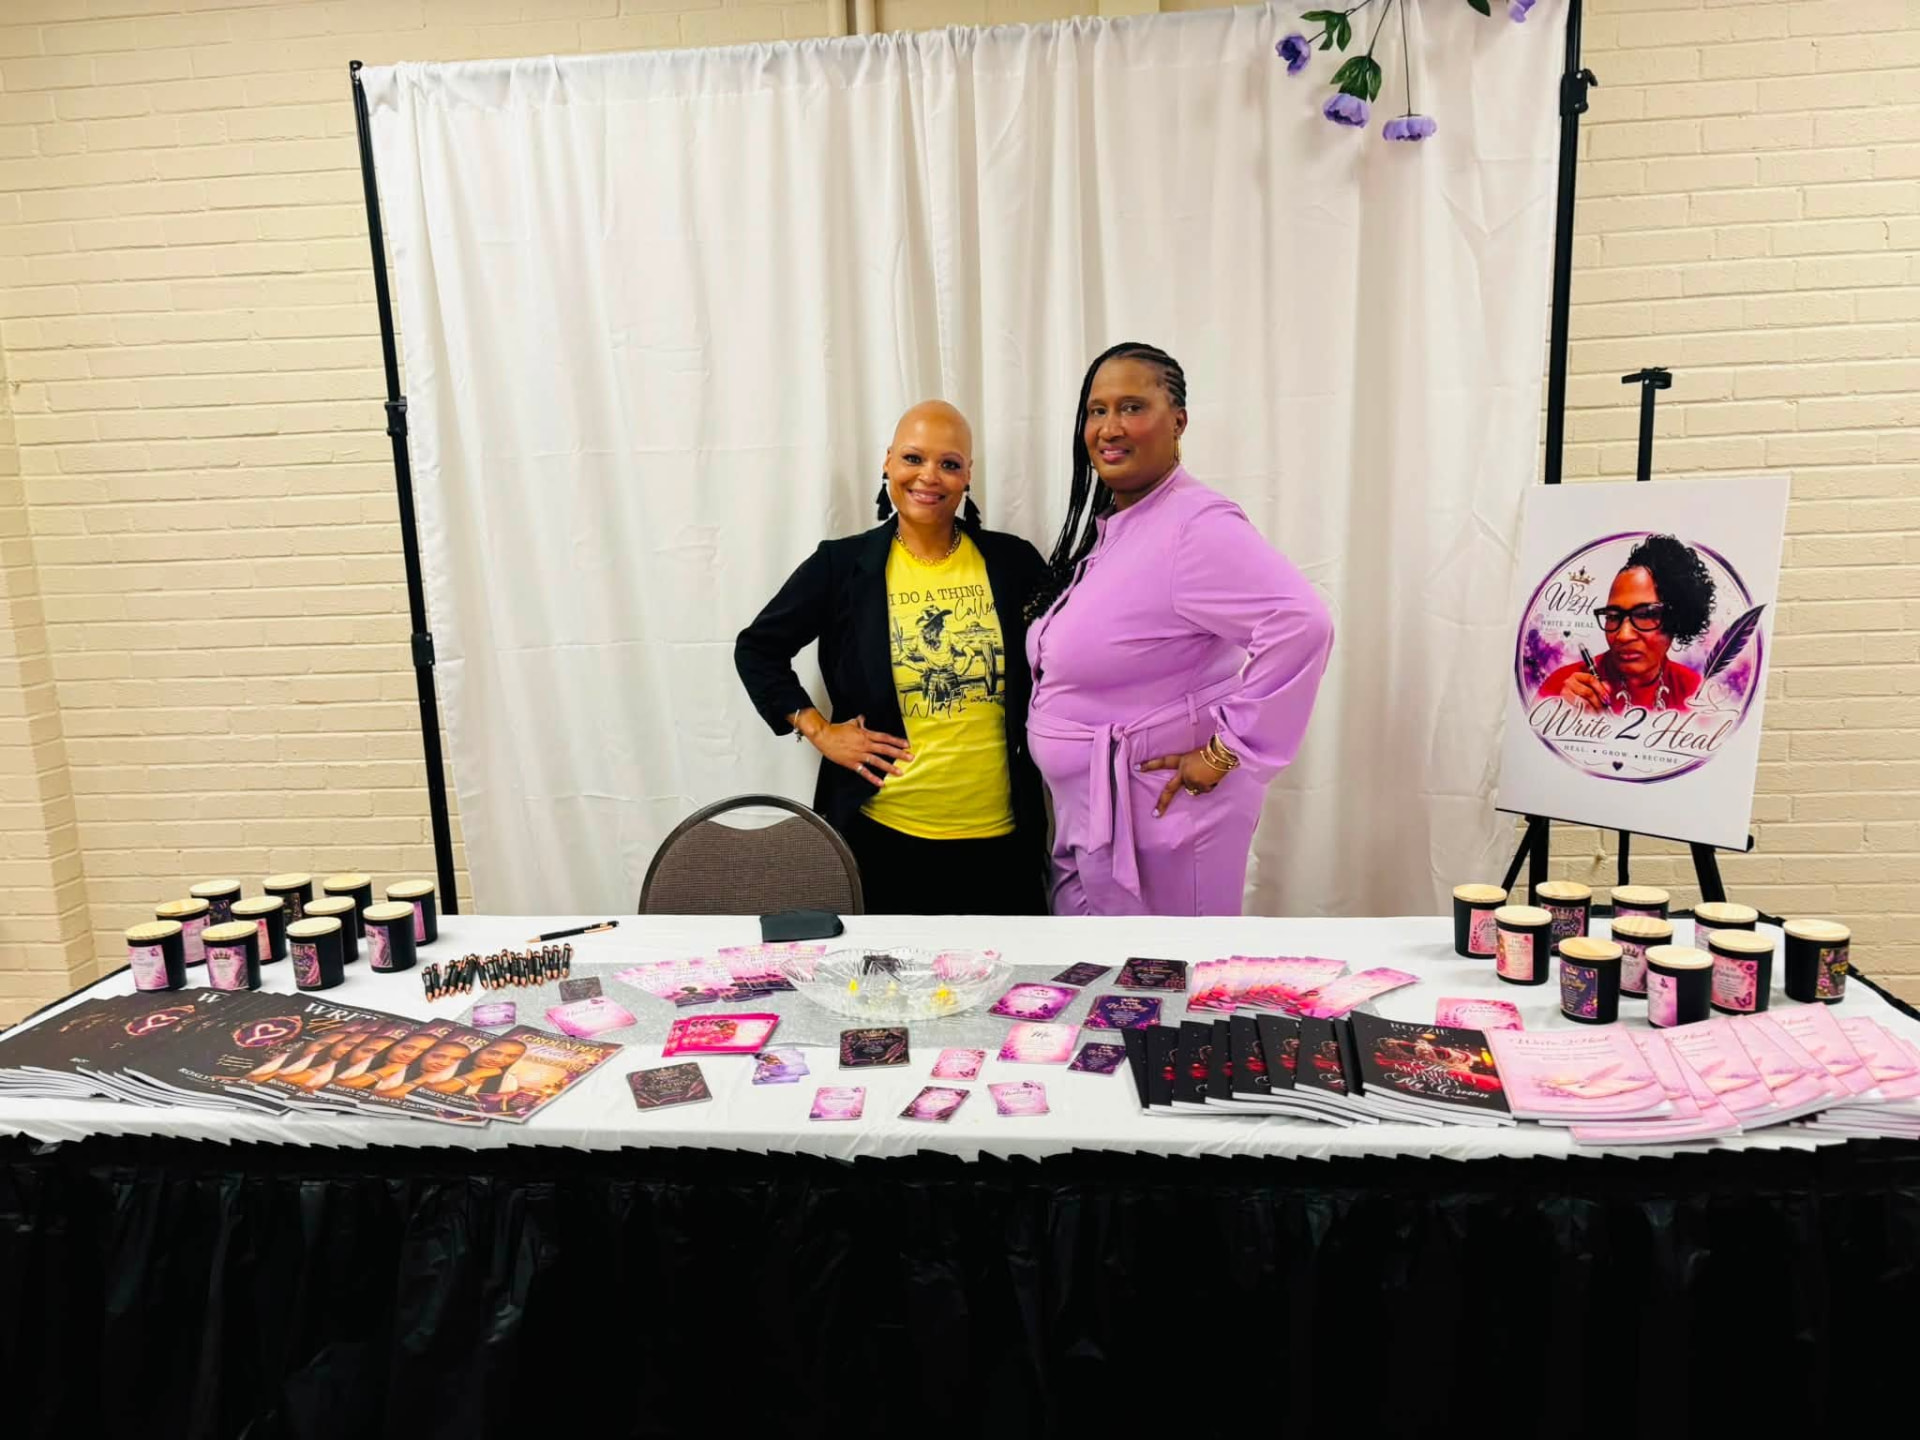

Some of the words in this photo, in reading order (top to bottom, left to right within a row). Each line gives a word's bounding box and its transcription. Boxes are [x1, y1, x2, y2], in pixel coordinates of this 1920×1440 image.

[888, 593, 897, 606] I
[900, 591, 920, 605] DO
[925, 590, 936, 602] A
[937, 584, 985, 601] THING
[1574, 621, 1595, 629] HEAL
[1529, 697, 1614, 738] Write
[1614, 707, 1648, 740] 2
[1643, 710, 1733, 752] Heal
